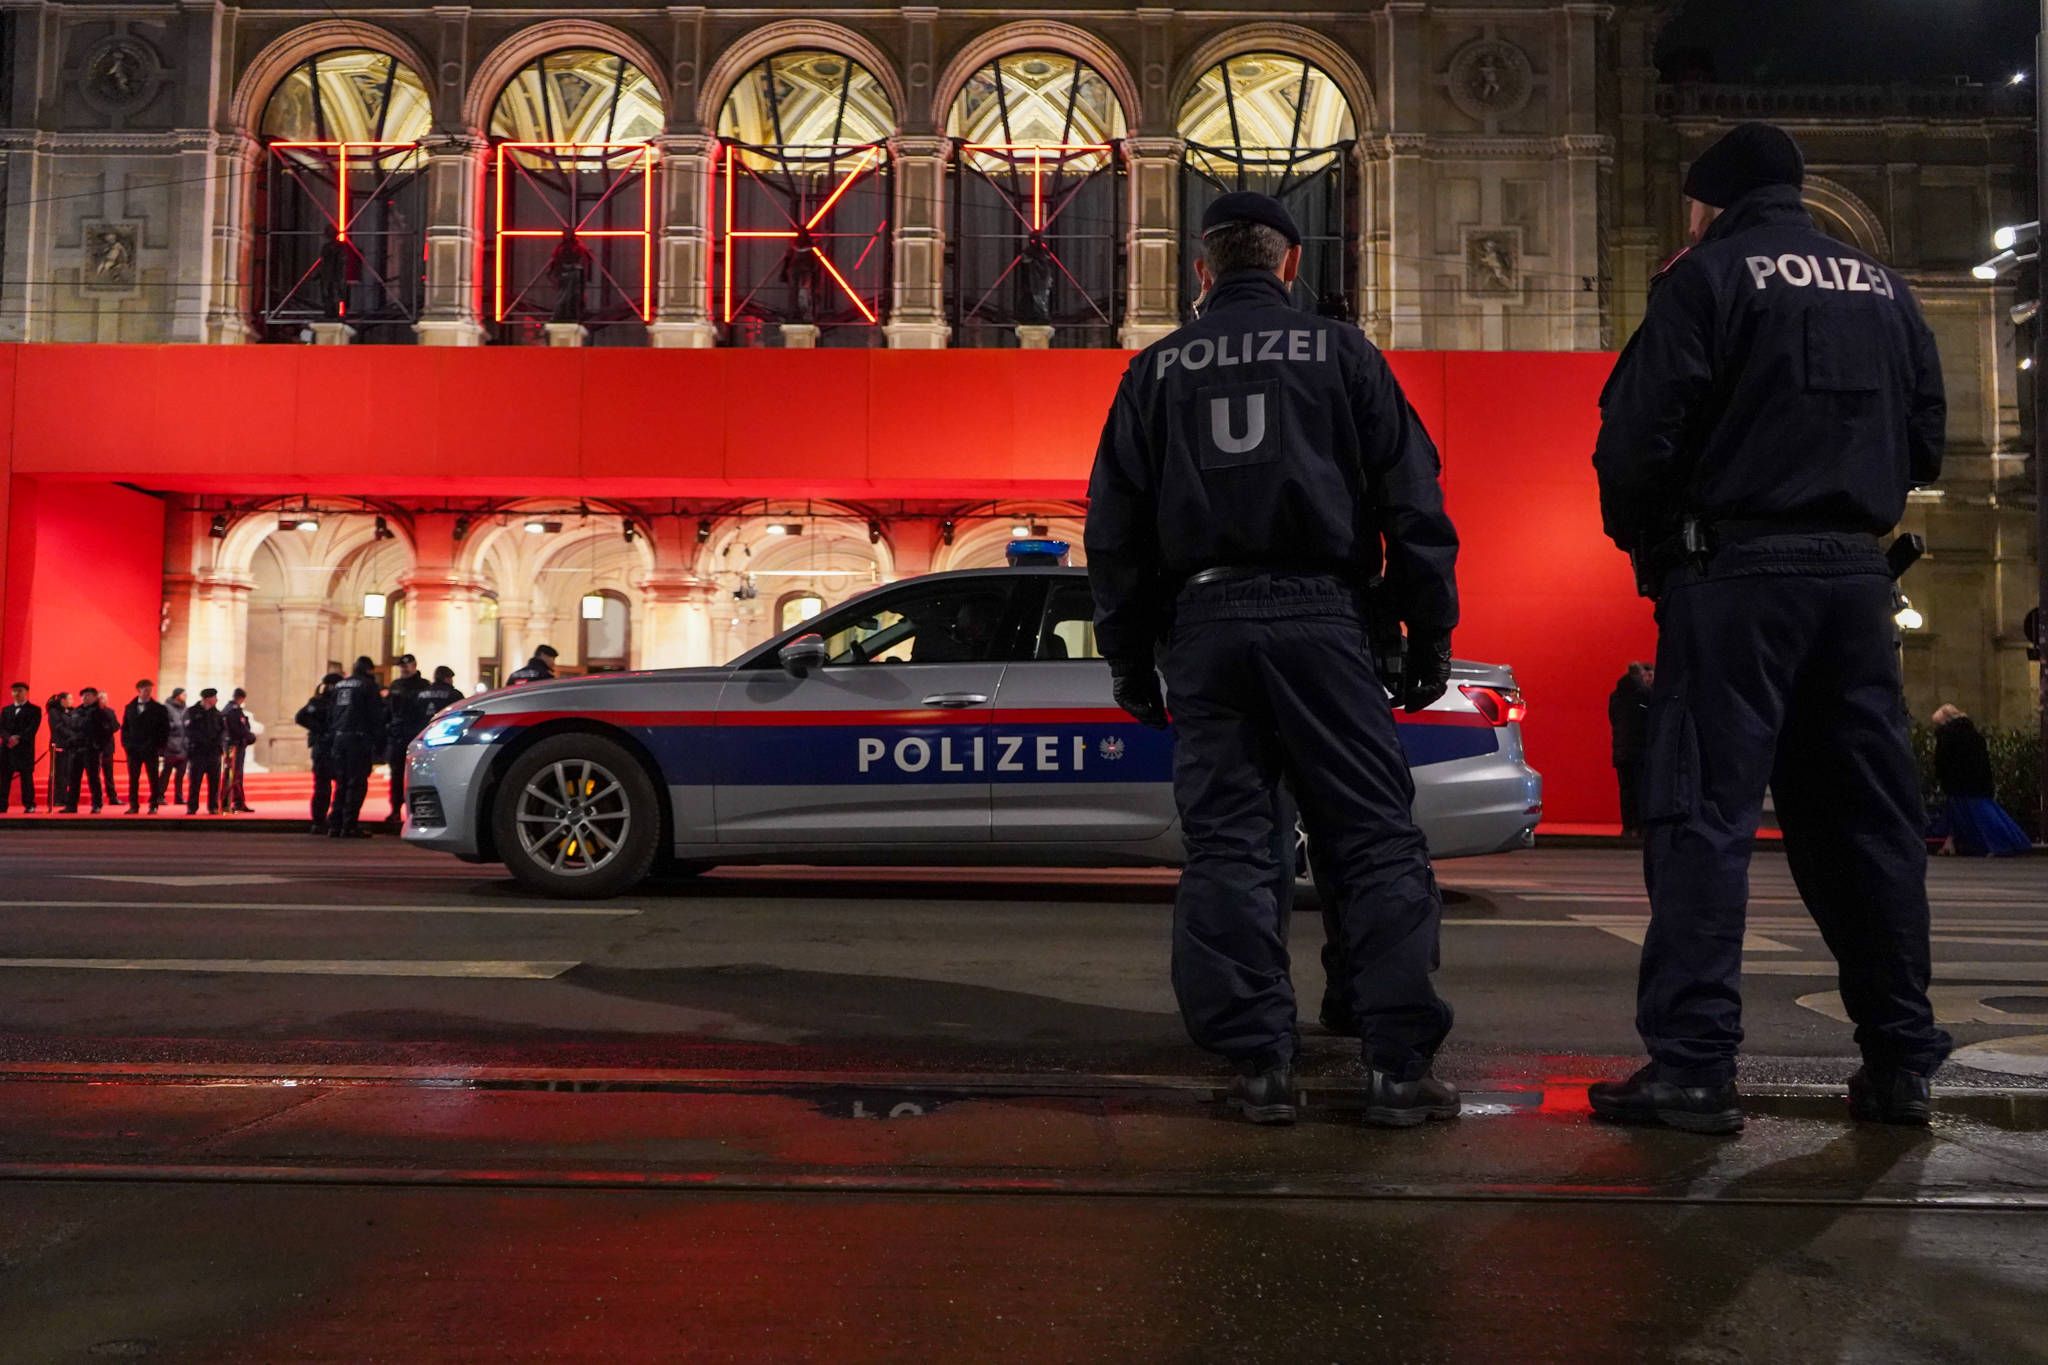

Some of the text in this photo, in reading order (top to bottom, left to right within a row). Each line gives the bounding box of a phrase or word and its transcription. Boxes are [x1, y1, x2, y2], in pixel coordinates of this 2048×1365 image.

[1744, 253, 1895, 300] POLIZEI
[1156, 329, 1327, 380] POLIZEI
[1210, 393, 1266, 453] U
[858, 736, 1084, 773] POLIZEI
